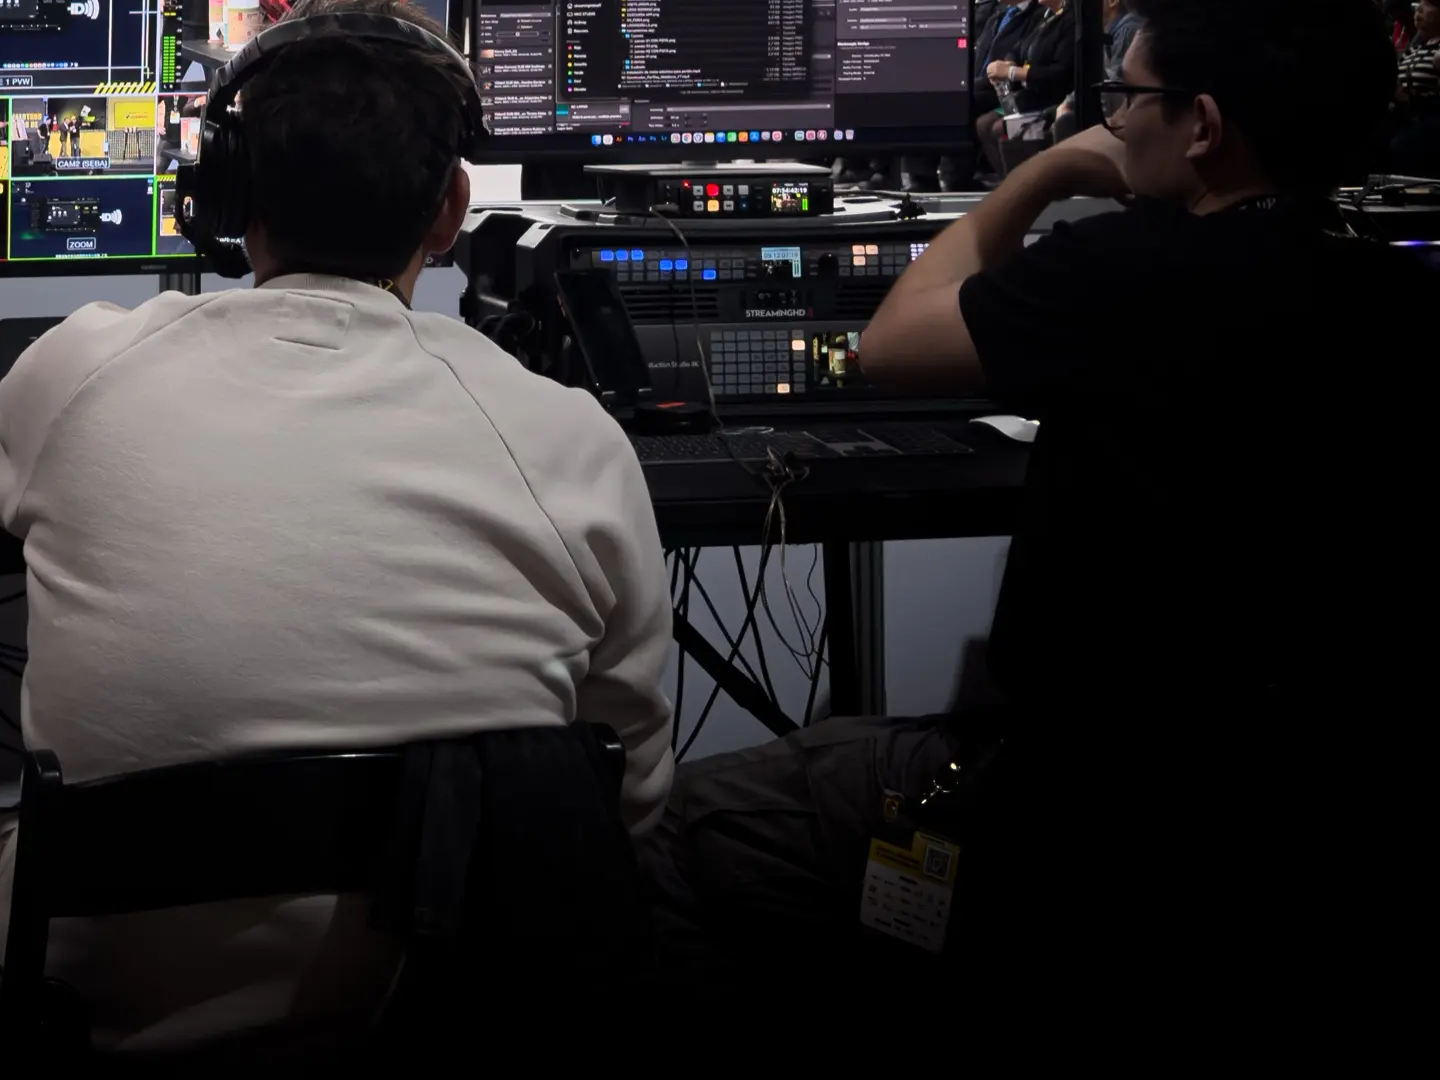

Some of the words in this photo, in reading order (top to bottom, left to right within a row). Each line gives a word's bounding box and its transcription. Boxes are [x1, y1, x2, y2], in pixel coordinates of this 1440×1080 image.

[6, 78, 10, 86] 1
[12, 78, 31, 86] PVW
[58, 160, 81, 168] CAM2
[69, 241, 94, 249] ZOOM
